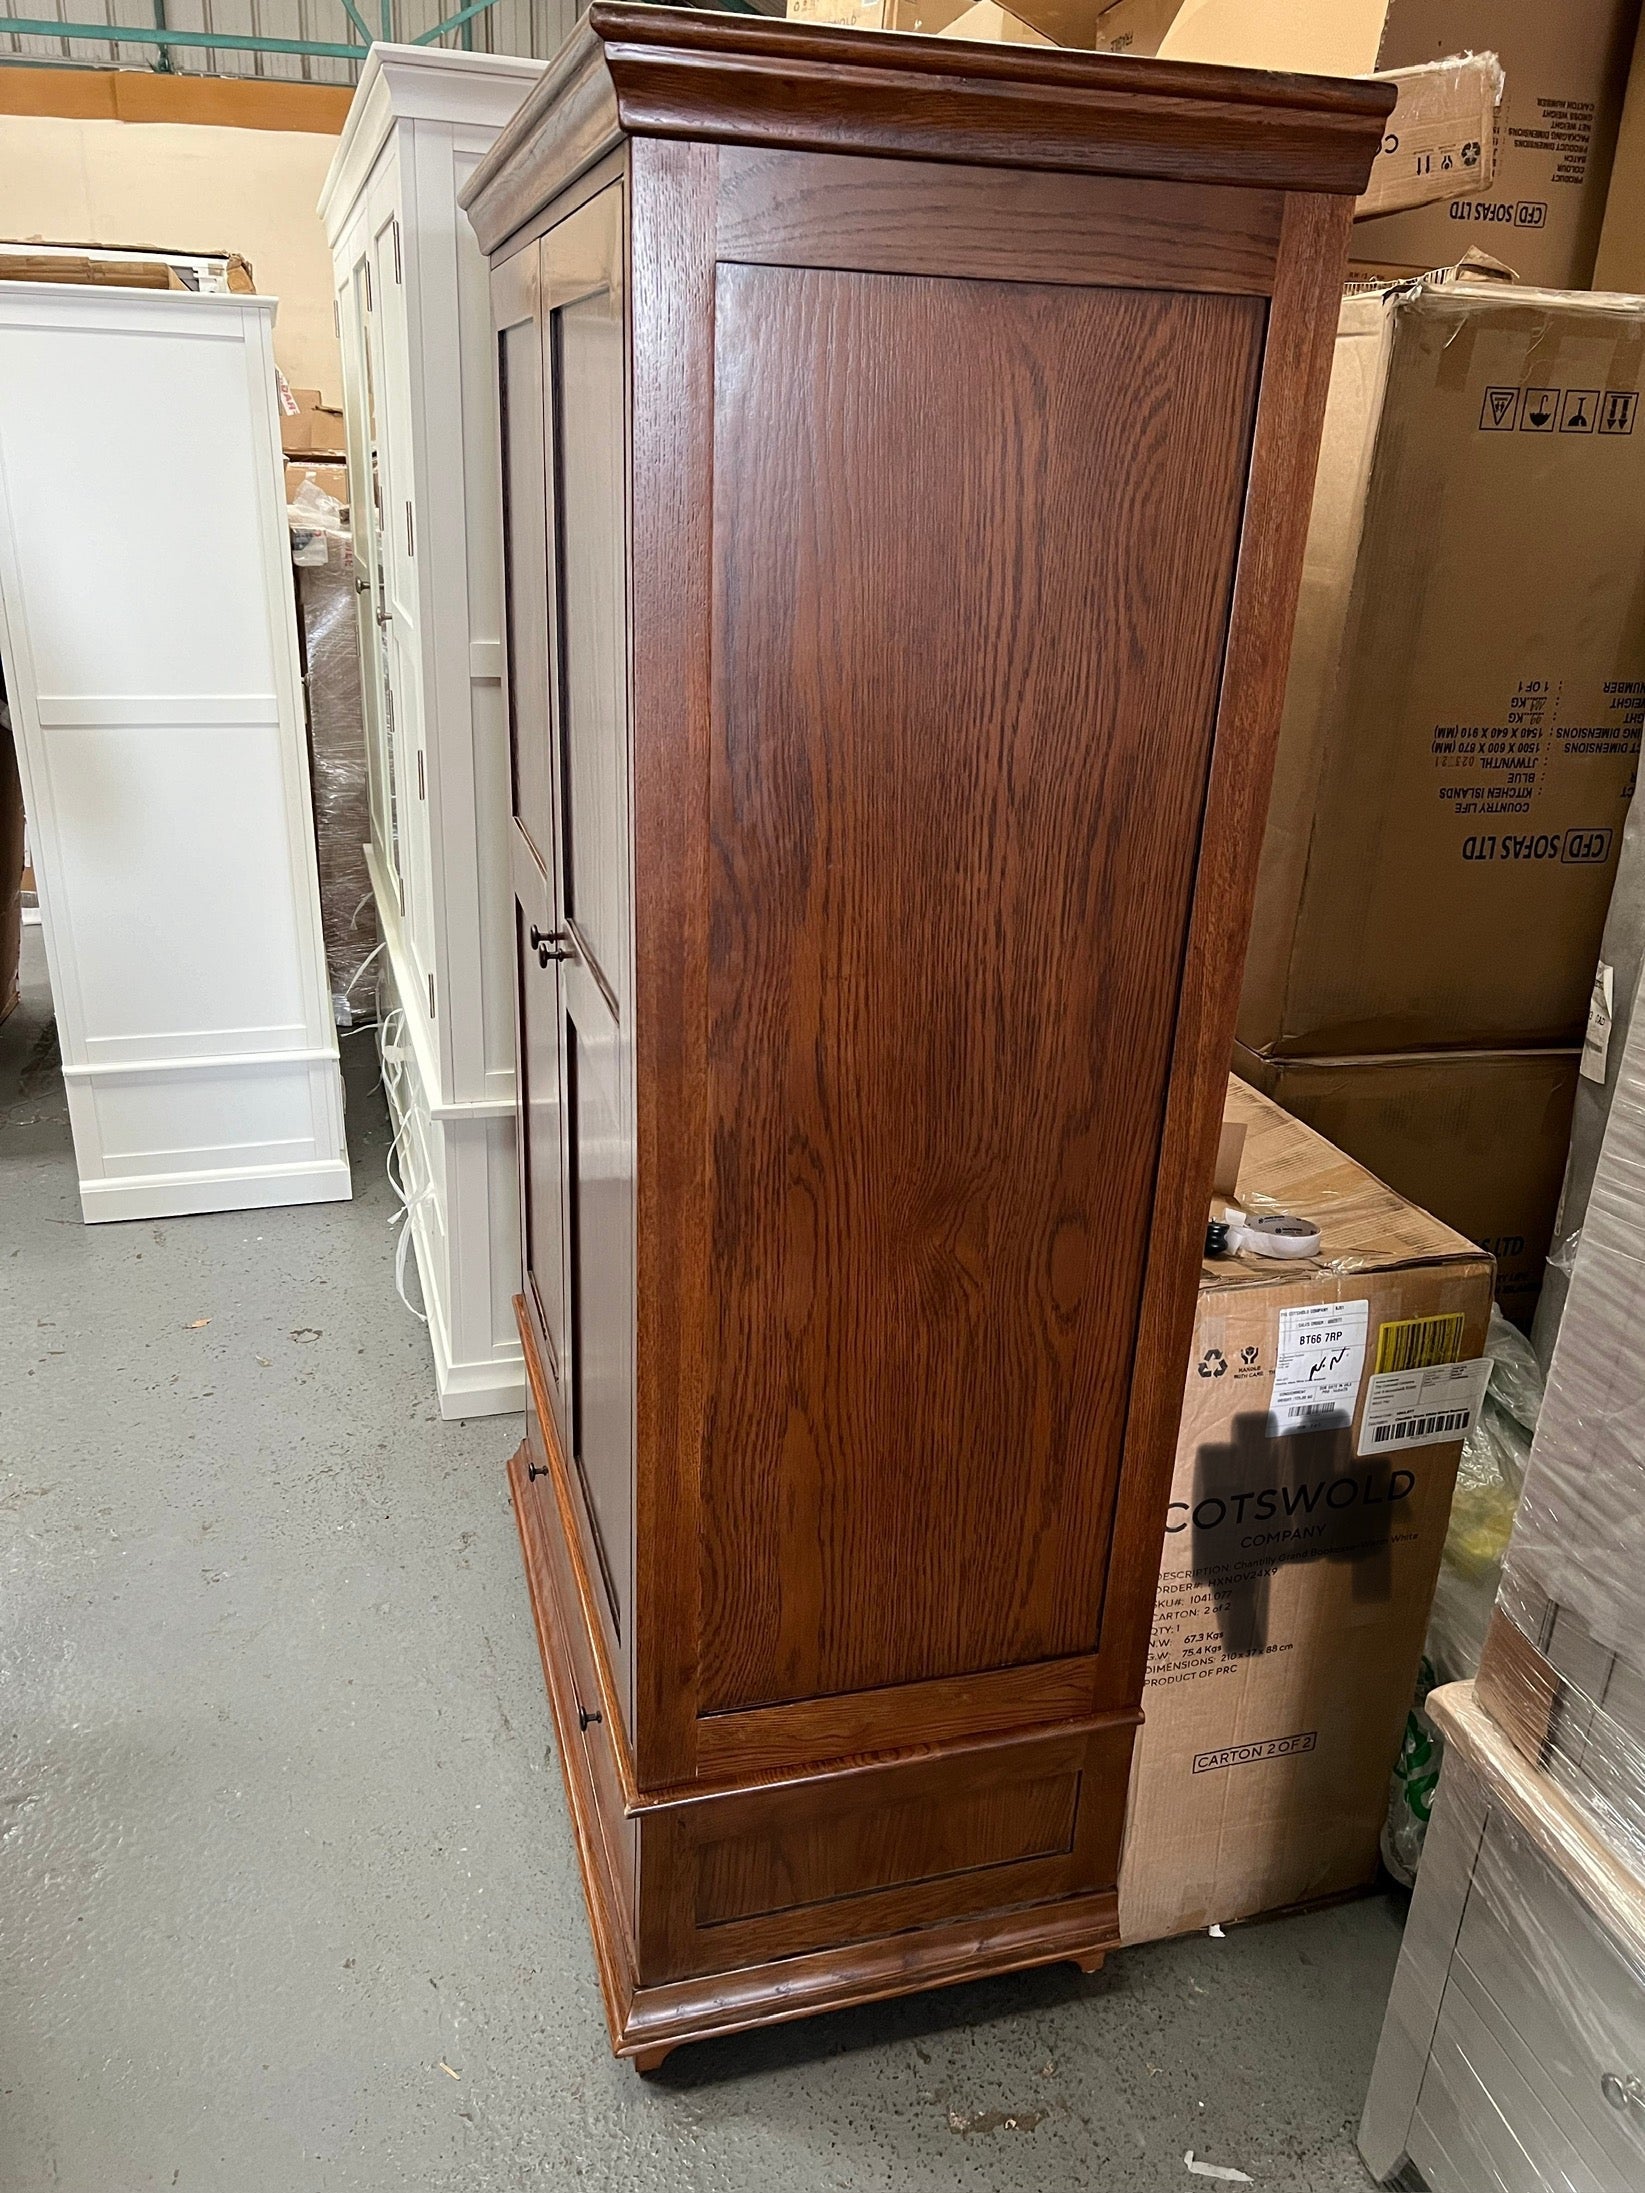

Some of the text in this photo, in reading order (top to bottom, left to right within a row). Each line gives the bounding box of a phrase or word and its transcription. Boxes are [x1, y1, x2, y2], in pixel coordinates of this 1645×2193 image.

[1550, 120, 1577, 131] WEIGHT
[1556, 143, 1588, 153] PRODUCT
[1563, 154, 1586, 163] BATCH
[1557, 164, 1585, 173] COLOUR
[1551, 174, 1583, 184] PRODUCT
[1450, 201, 1543, 224] CFD SOFAS LTD
[1525, 681, 1540, 692] OF
[1434, 725, 1458, 739] (MM)
[1461, 728, 1478, 738] 910
[1481, 728, 1489, 738] X
[1491, 728, 1508, 738] 640
[1511, 728, 1518, 738] X
[1521, 728, 1543, 738] 1540
[1431, 740, 1456, 753] (MM)
[1458, 743, 1475, 753] 870
[1479, 743, 1486, 753] X
[1488, 743, 1506, 753] 600
[1508, 743, 1516, 753] X
[1517, 743, 1540, 753] 1500
[1564, 743, 1628, 753] DIMENSIONS
[1507, 773, 1535, 783] BLUE
[1439, 787, 1532, 799] KITCHEN ISLANDS
[1455, 802, 1529, 813] COUNTRY LIFE
[1462, 834, 1604, 860] CFD SOFAS LTD
[1300, 1331, 1343, 1345] BT66 7RP
[1165, 1469, 1416, 1532] COTSWOLD
[1240, 1523, 1327, 1549] COMPANY
[1234, 1552, 1275, 1571] Chantilly
[1278, 1549, 1308, 1562] Grand
[1391, 1532, 1419, 1543] White
[1208, 1567, 1278, 1587] HXNOV24X9
[1204, 1606, 1210, 1615] 2
[1212, 1604, 1222, 1613] of
[1224, 1602, 1231, 1611] 2
[1151, 1626, 1174, 1636] QTY:
[1184, 1633, 1204, 1644] 67.3
[1206, 1631, 1224, 1641] Kgs
[1182, 1646, 1202, 1658] 75.4
[1204, 1644, 1222, 1654] Kgs
[1220, 1652, 1237, 1662] 210
[1245, 1649, 1257, 1658] 37
[1266, 1644, 1278, 1654] 88
[1279, 1643, 1293, 1652] cm
[1144, 1664, 1238, 1688] PRODUCT OF PRC
[1197, 1736, 1311, 1768] CARTON 2 OF 2
